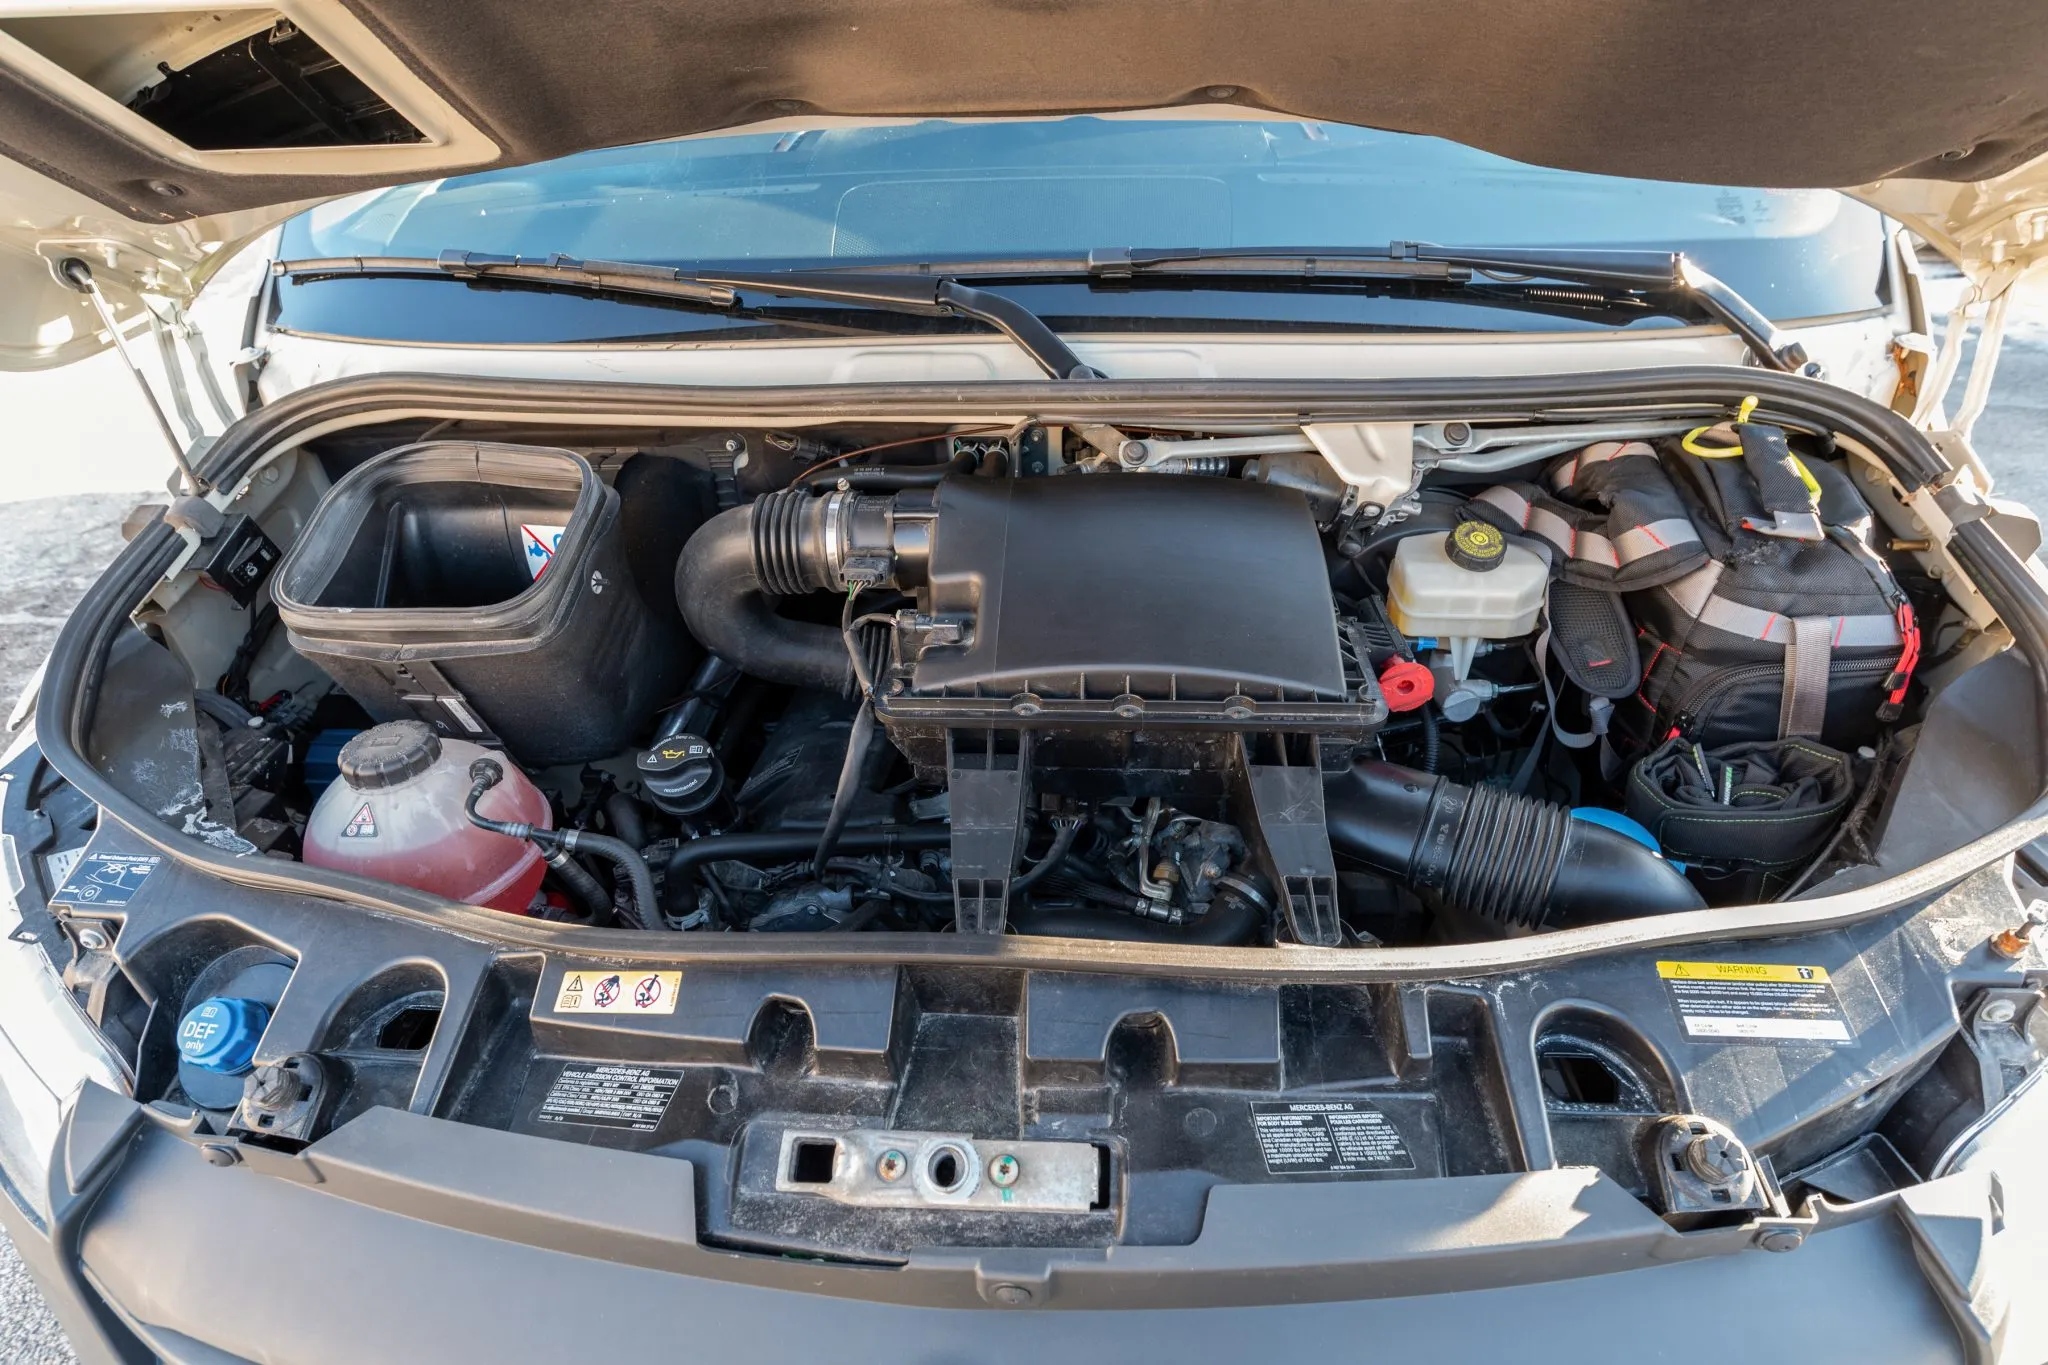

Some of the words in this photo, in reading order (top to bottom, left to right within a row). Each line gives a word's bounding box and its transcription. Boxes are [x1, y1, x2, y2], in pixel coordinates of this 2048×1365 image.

[664, 779, 698, 793] recommended
[1715, 965, 1768, 975] WARNING
[183, 1020, 219, 1040] DEF
[185, 1039, 204, 1052] only
[595, 1067, 641, 1075] MERCEDES-BENZ
[638, 1076, 678, 1084] INFORMATION
